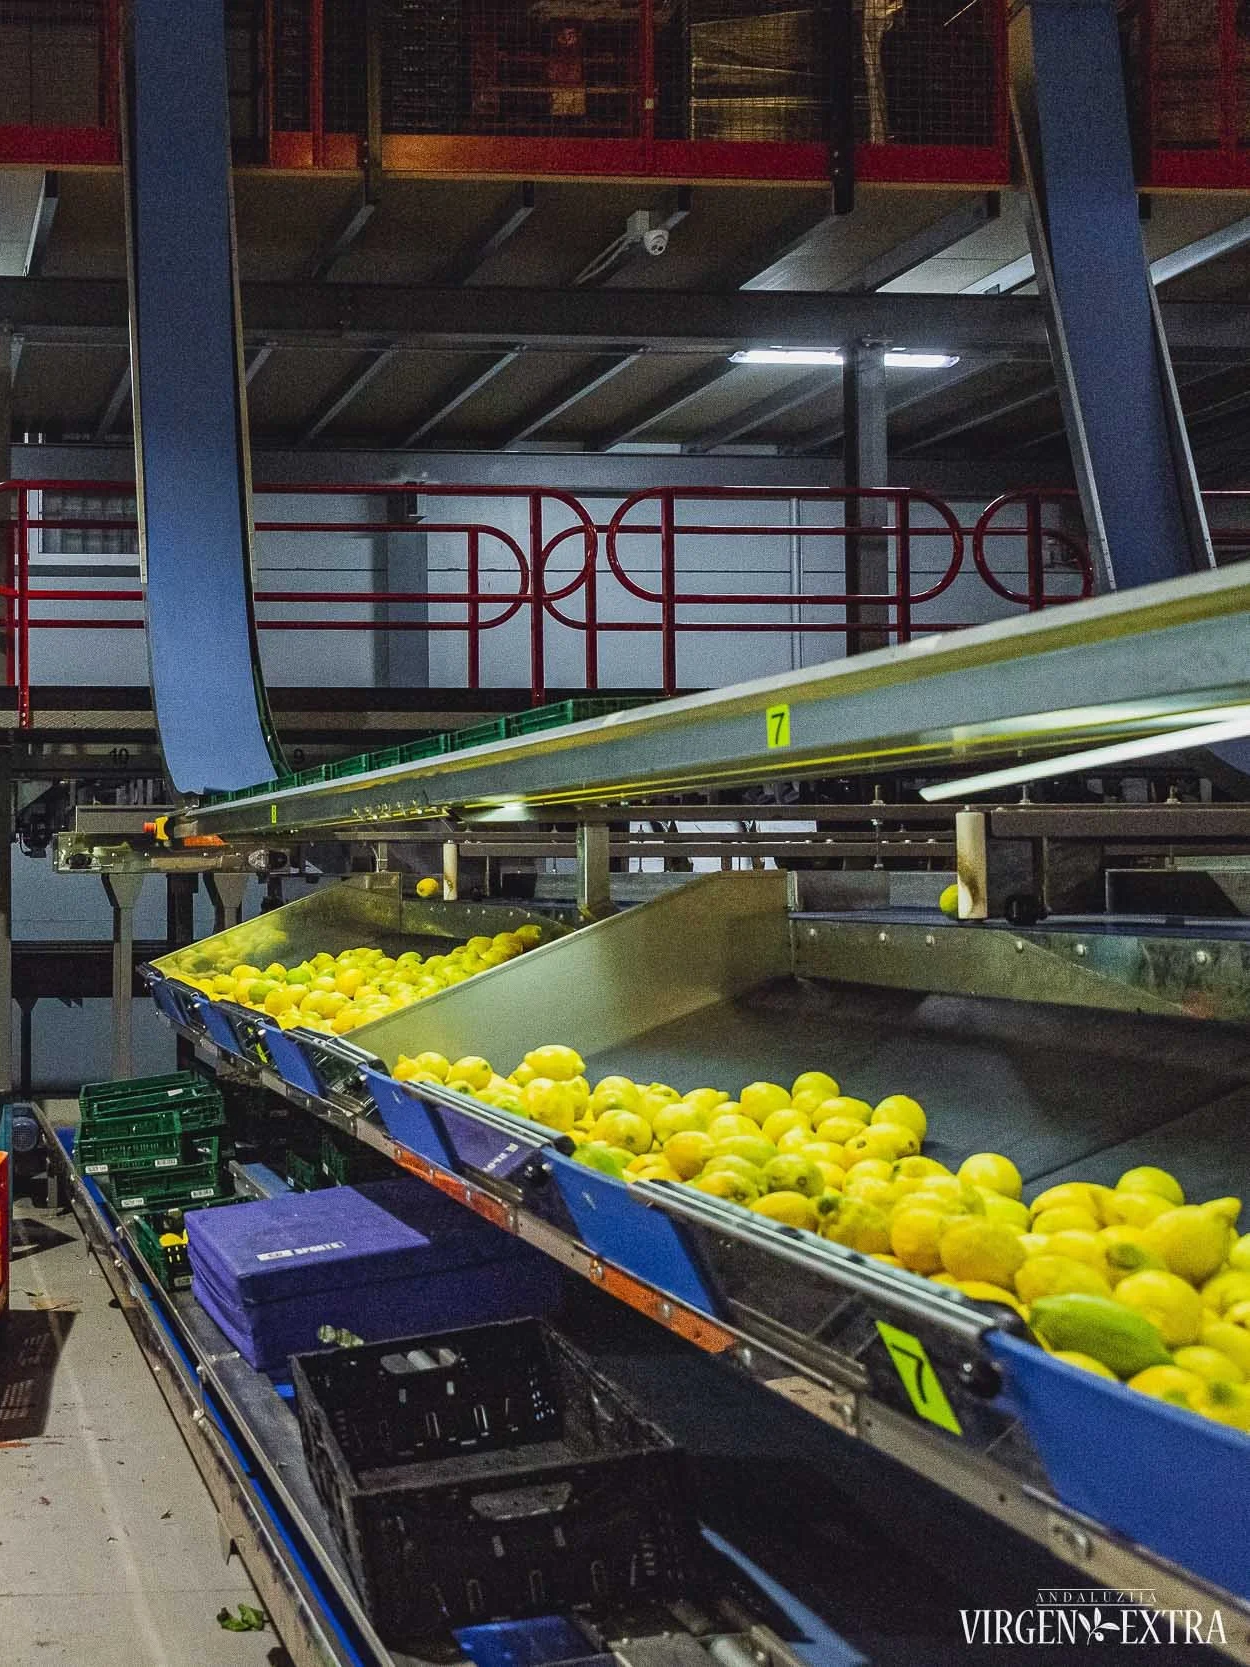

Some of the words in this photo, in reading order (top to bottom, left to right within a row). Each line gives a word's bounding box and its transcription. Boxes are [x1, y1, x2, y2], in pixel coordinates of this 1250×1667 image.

[771, 712, 785, 744] 7
[109, 748, 130, 767] 10
[890, 1343, 926, 1404] 7
